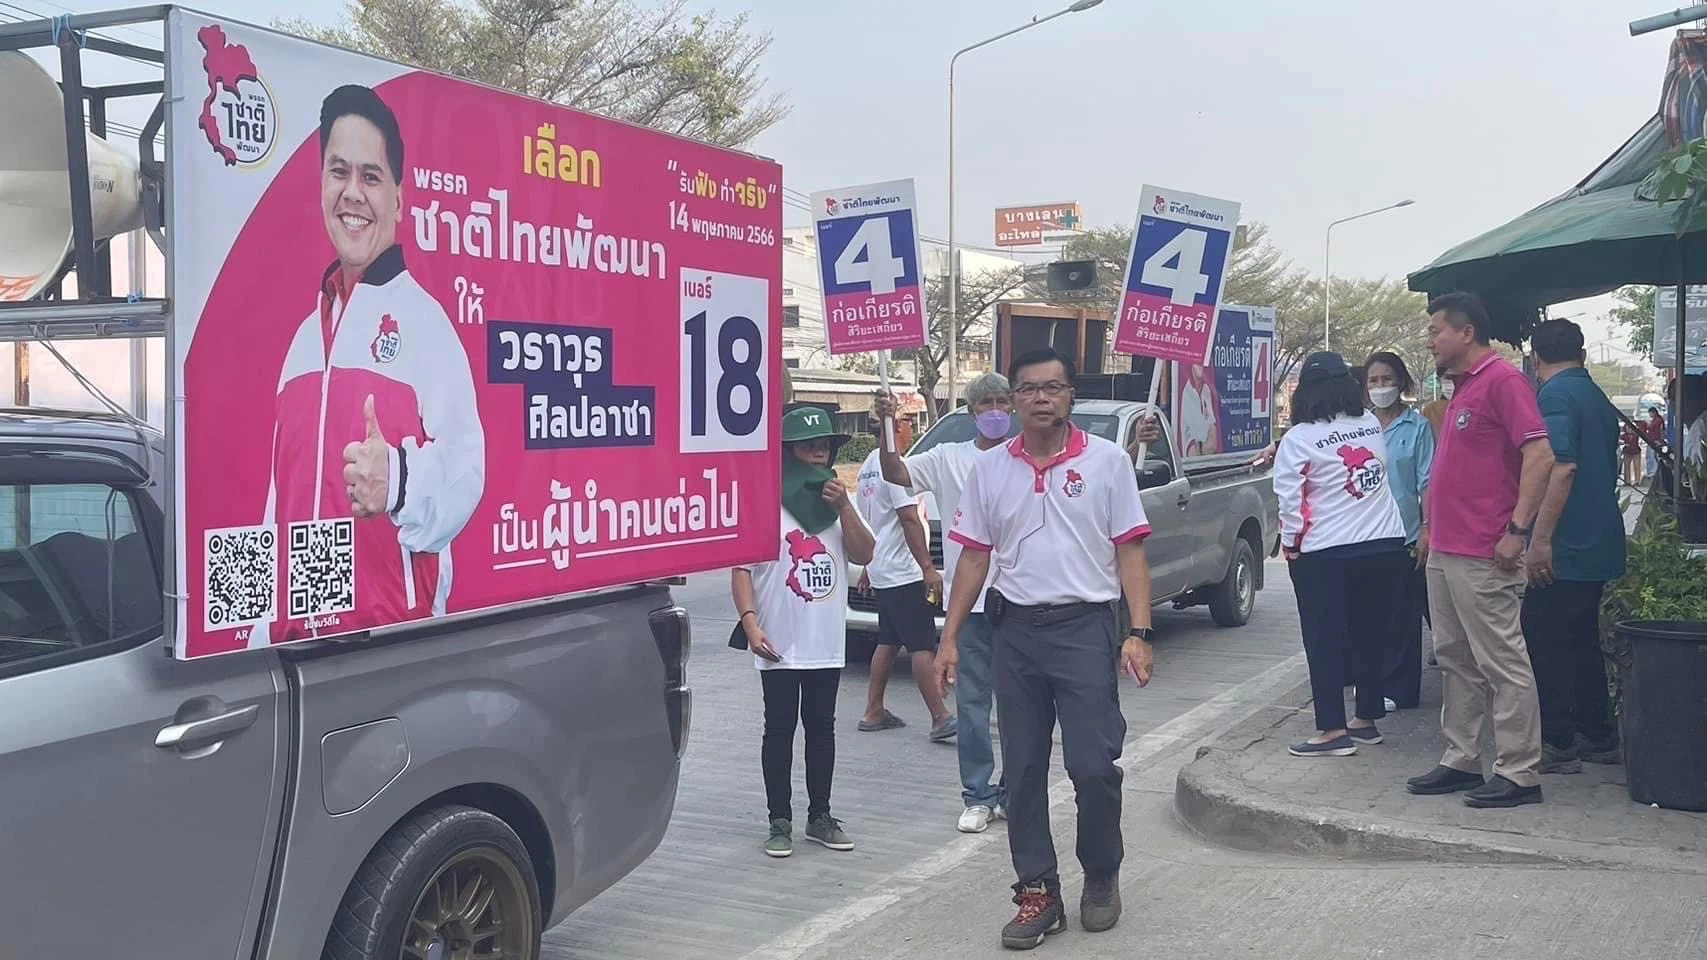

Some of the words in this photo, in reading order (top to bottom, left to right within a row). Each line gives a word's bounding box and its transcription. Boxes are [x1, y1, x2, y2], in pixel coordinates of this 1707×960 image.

[221, 102, 265, 143] ไทย
[235, 102, 265, 122] ชาติ
[236, 141, 260, 153] พัฒนา
[523, 122, 601, 188] เลือก
[413, 166, 468, 196] พรรค
[843, 196, 901, 210] ชาติไทยพัฒนา
[1169, 204, 1224, 222] ชาติไทยพัฒนา
[410, 187, 667, 280] ชาติไทยพัฒนา
[669, 200, 689, 232] 14
[691, 217, 744, 241] พฤษภาคม
[747, 225, 775, 246] 2566
[834, 217, 904, 295] 4
[1140, 228, 1209, 307] 4
[454, 276, 485, 325] ให้
[683, 276, 713, 299] เบอร์
[832, 294, 916, 323] ก่อเกียรติ
[1126, 300, 1208, 333] ก่อเกียรติ
[684, 310, 764, 436] 18
[1254, 342, 1269, 413] 4
[529, 394, 651, 439] ศิลปอาชา
[803, 415, 820, 426] VT
[1315, 427, 1381, 449] ชาติไทยพัฒน
[802, 567, 832, 587] ไทย
[234, 630, 249, 641] AR
